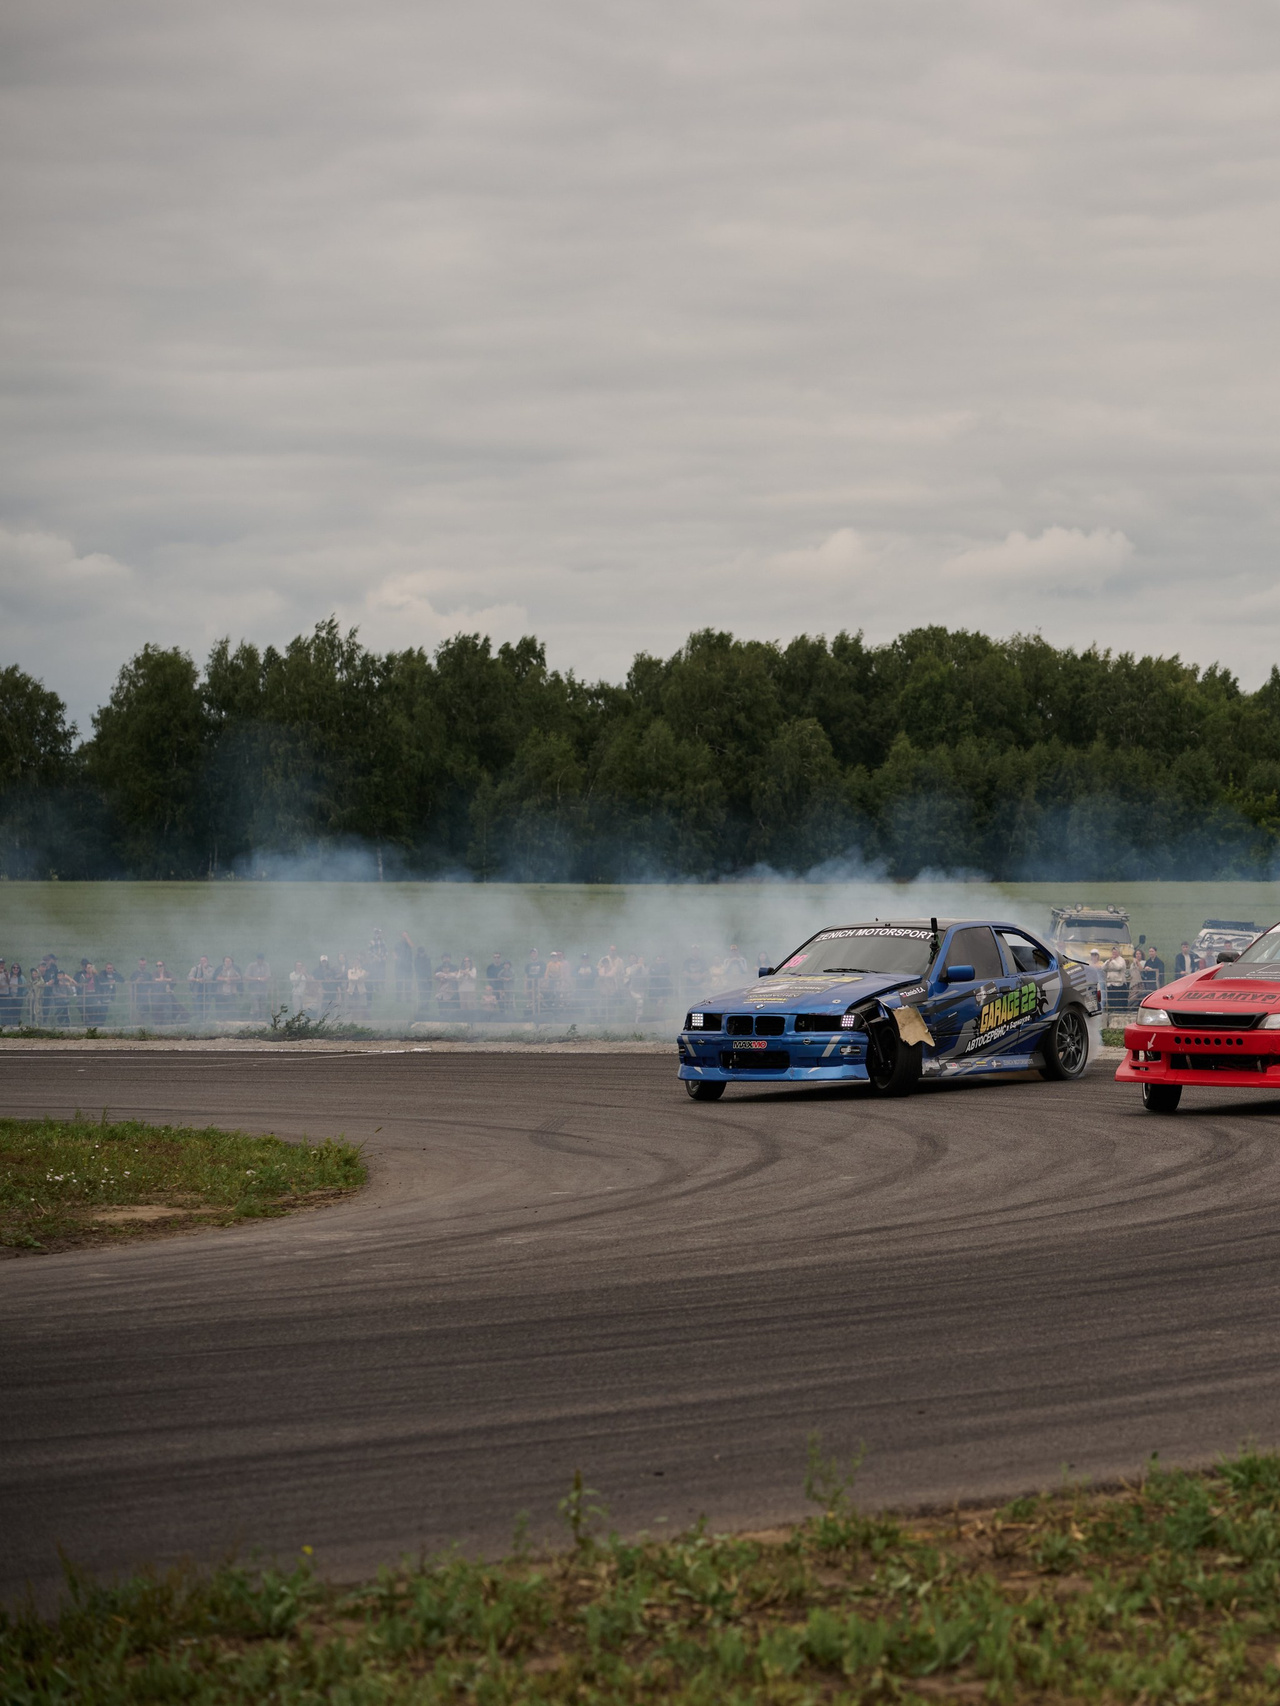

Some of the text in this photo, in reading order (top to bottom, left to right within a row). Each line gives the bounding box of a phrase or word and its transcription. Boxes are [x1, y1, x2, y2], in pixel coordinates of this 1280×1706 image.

[816, 928, 935, 942] ZENICH MOTORSPORT
[1184, 992, 1277, 1002] ШАМПУР
[980, 981, 1037, 1034] GARAGE 22
[733, 1040, 768, 1050] MAXMO
[965, 1024, 1008, 1053] АВТОСЕРВИС
